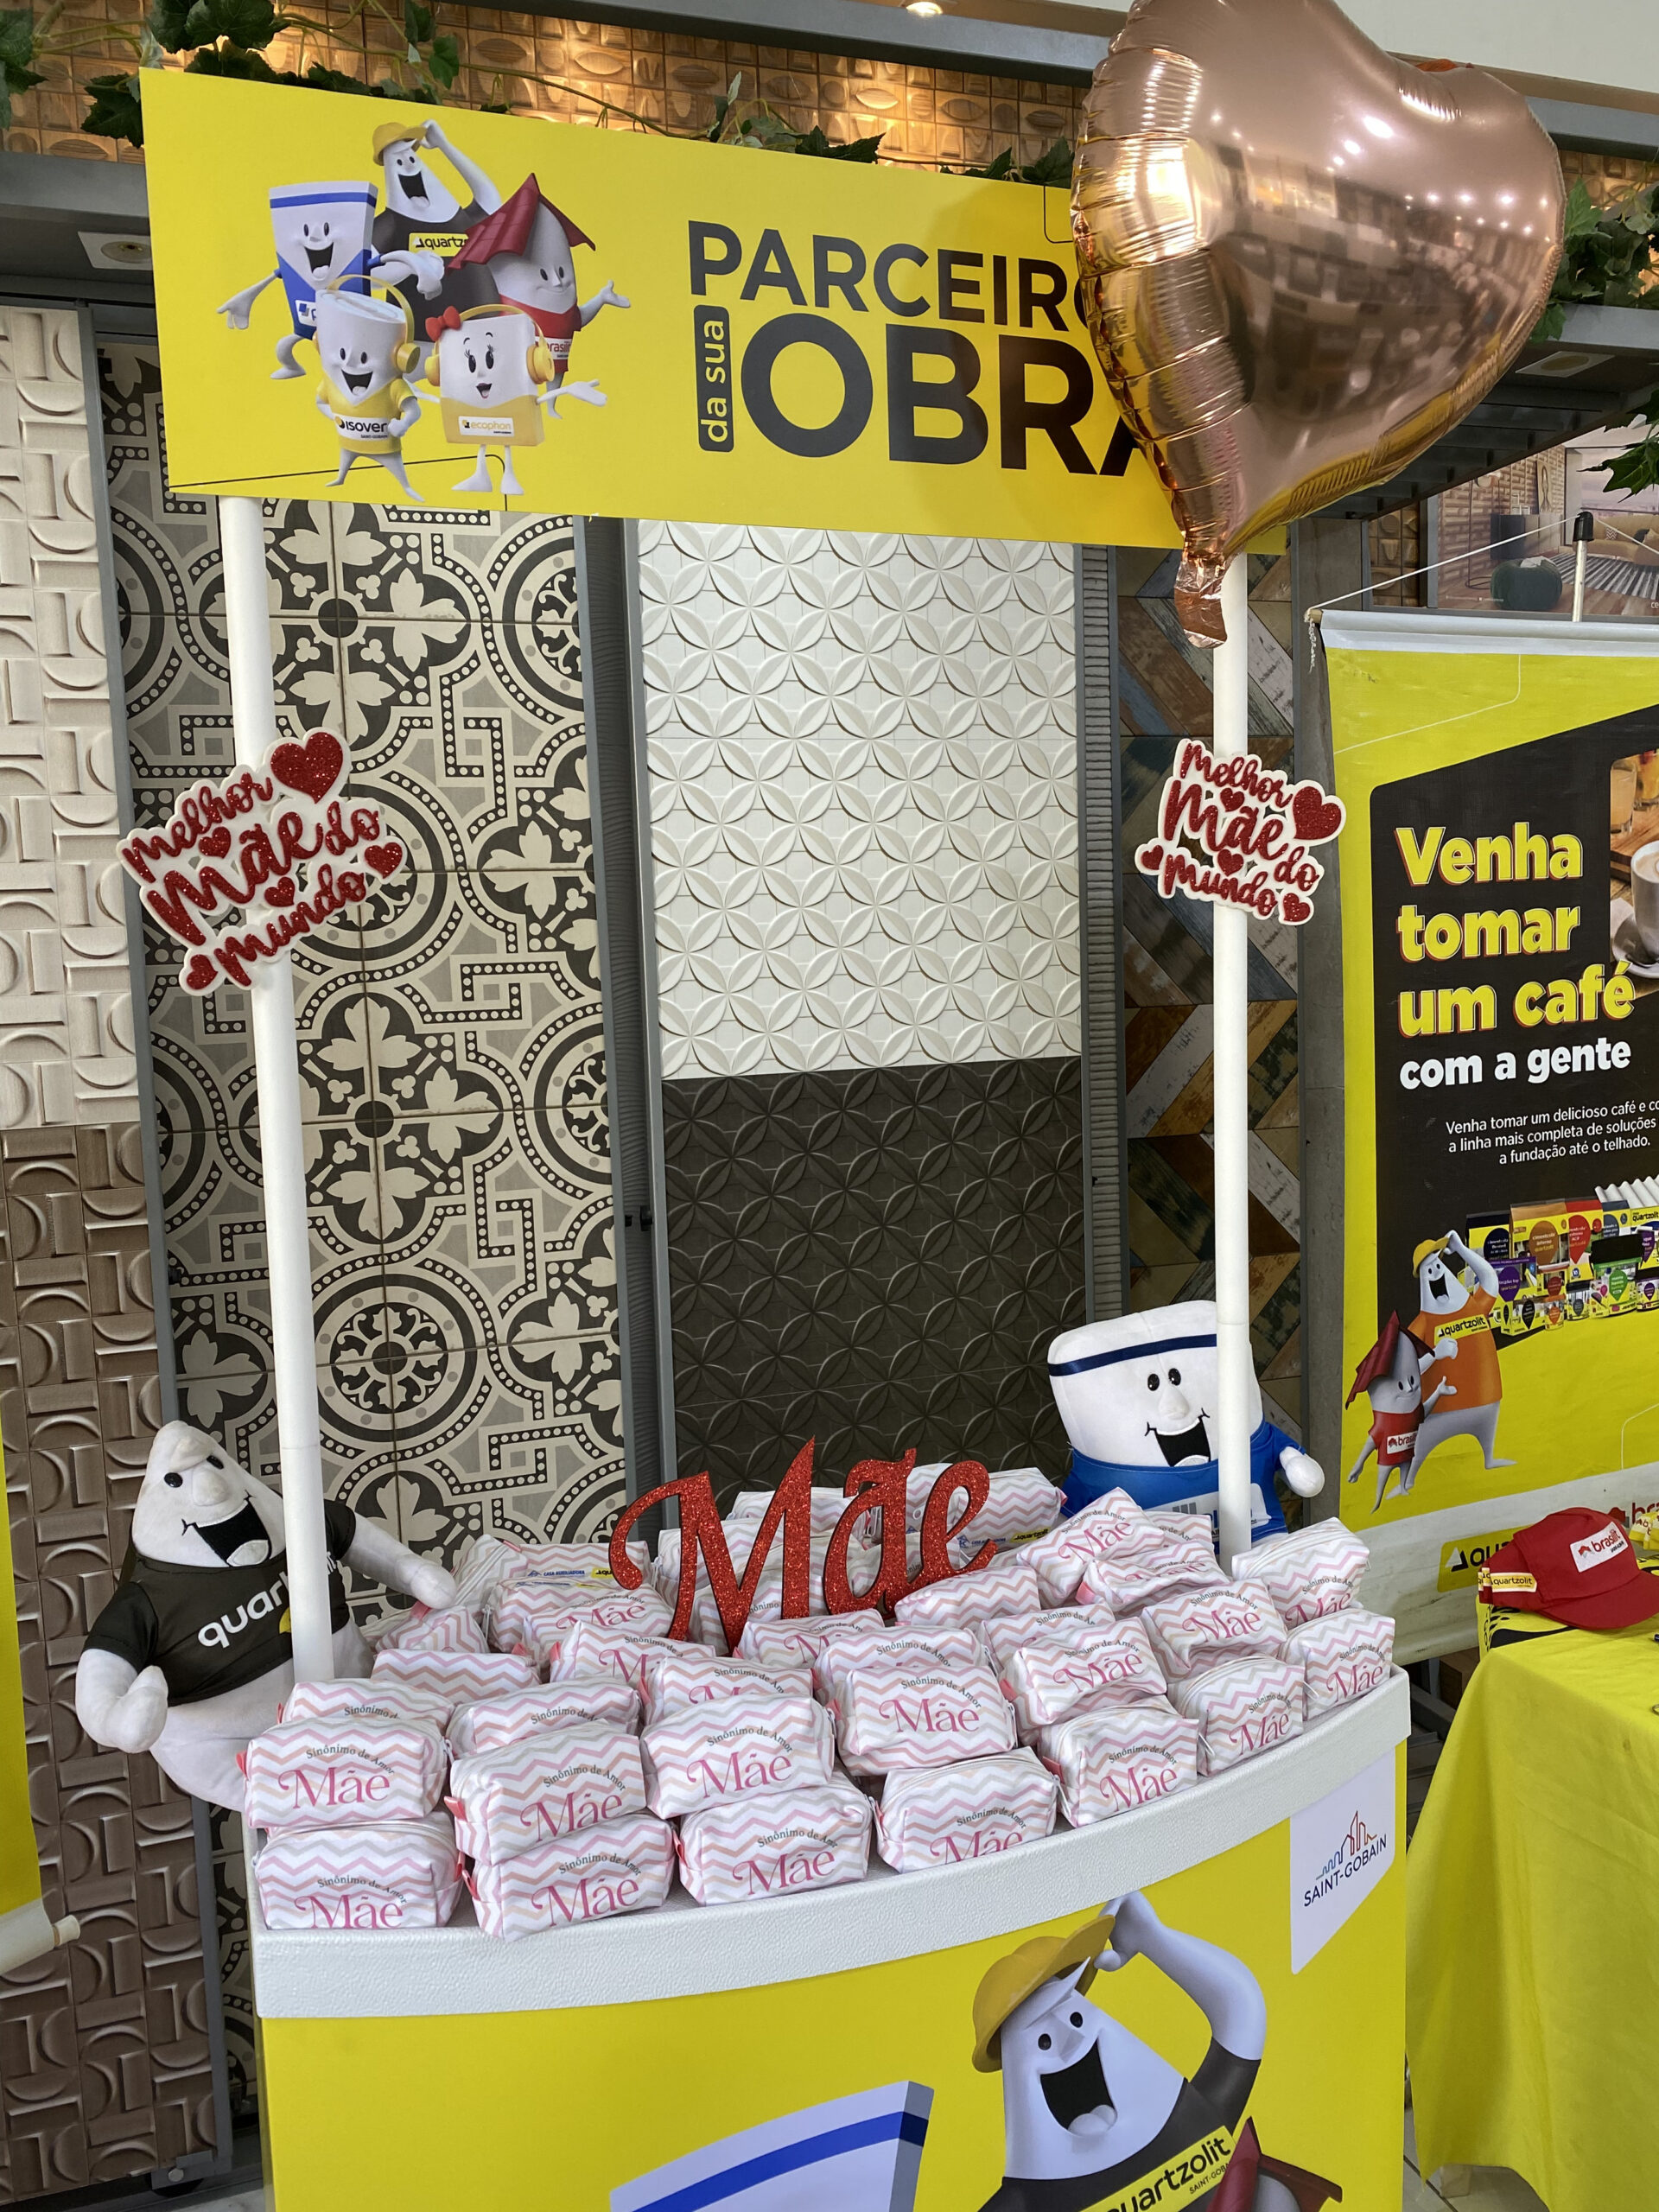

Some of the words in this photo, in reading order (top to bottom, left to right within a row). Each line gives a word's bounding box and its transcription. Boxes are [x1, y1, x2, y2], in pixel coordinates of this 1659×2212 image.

[689, 220, 1089, 333] PARCEIR
[702, 320, 727, 383] sua
[471, 422, 512, 430] ecophon
[701, 404, 728, 443] da
[326, 801, 379, 856] do
[1274, 846, 1319, 892] do
[1395, 822, 1583, 886] Venha
[1397, 904, 1580, 962] tomar
[1399, 984, 1497, 1036] um
[1513, 961, 1635, 1027] café
[1400, 1050, 1483, 1090] com
[1494, 1051, 1517, 1080] a
[1528, 1037, 1631, 1085] gente
[1446, 1120, 1487, 1135] Venha
[1491, 1115, 1528, 1130] tomar
[1531, 1112, 1550, 1124] um
[1554, 1107, 1608, 1122] delicioso
[1611, 1100, 1636, 1116] café
[1638, 1103, 1646, 1112] e
[1448, 1142, 1457, 1153] a
[1460, 1136, 1491, 1152] linha
[1495, 1133, 1524, 1147] mais
[1527, 1125, 1583, 1141] completa
[1586, 1122, 1603, 1135] de
[1606, 1116, 1656, 1134] soluções
[1499, 1154, 1507, 1164] a
[1510, 1144, 1567, 1163] fundação
[1569, 1141, 1589, 1155] até
[1592, 1141, 1600, 1153] o
[1604, 1134, 1650, 1151] telhado.
[1445, 1316, 1486, 1336] quartzolit
[1104, 1510, 1126, 1522] Amor
[608, 1434, 998, 1654] Mãe
[1058, 1522, 1135, 1565] Mãe
[1332, 1575, 1342, 1584] de
[1493, 1577, 1533, 1586] quartzolit
[1073, 1611, 1084, 1620] de
[1191, 1589, 1224, 1606] Sinônimo
[1225, 1589, 1236, 1598] de
[1236, 1594, 1258, 1611] Amor
[1182, 1610, 1262, 1642] Mãe
[625, 1636, 664, 1648] Sinônimo
[666, 1643, 677, 1653] de
[876, 1640, 918, 1655] Sinônimo
[919, 1642, 931, 1652] de
[1101, 1639, 1113, 1648] de
[1115, 1638, 1140, 1653] Amor
[715, 1668, 758, 1678] Sinônimo
[759, 1673, 770, 1682] de
[1052, 1652, 1144, 1694] Mãe
[1325, 1664, 1382, 1703] Mãe
[901, 1675, 944, 1689] Sinônimo
[946, 1679, 957, 1690] de
[959, 1686, 982, 1708] Amor
[344, 1703, 389, 1718] Sinônimo
[531, 1707, 576, 1725] Sinônimo
[577, 1708, 588, 1719] de
[879, 1698, 979, 1732] Mãe
[707, 1726, 754, 1747] Sinônimo
[756, 1726, 769, 1736] de
[770, 1732, 792, 1753] Amor
[1229, 1713, 1289, 1756] Mãe
[306, 1744, 355, 1759] Sinônimo
[358, 1748, 370, 1760] de
[371, 1755, 396, 1774] Amor
[1108, 1745, 1148, 1764] Sinônimo
[1160, 1748, 1178, 1764] Amor
[277, 1766, 390, 1808] Mãe
[543, 1766, 588, 1788] Sinônimo
[590, 1764, 602, 1775] de
[603, 1771, 626, 1791] Amor
[686, 1751, 791, 1799] Mãe
[1099, 1766, 1177, 1812] Mãe
[519, 1791, 622, 1842] Mãe
[957, 1808, 998, 1827] Sinônimo
[999, 1807, 1008, 1816] de
[1009, 1810, 1027, 1829] Amor
[758, 1830, 804, 1848] Sinônimo
[807, 1828, 818, 1840] de
[558, 1855, 607, 1874] Sinônimo
[609, 1853, 621, 1864] de
[622, 1859, 642, 1876] Amor
[732, 1851, 836, 1896] Mãe
[1304, 1834, 1387, 1907] SAINT-GOBAIN
[317, 1875, 366, 1889] Sinônimo
[368, 1879, 381, 1890] de
[383, 1885, 408, 1904] Amor
[531, 1877, 639, 1927] Mãe
[294, 1894, 403, 1929] Mãe
